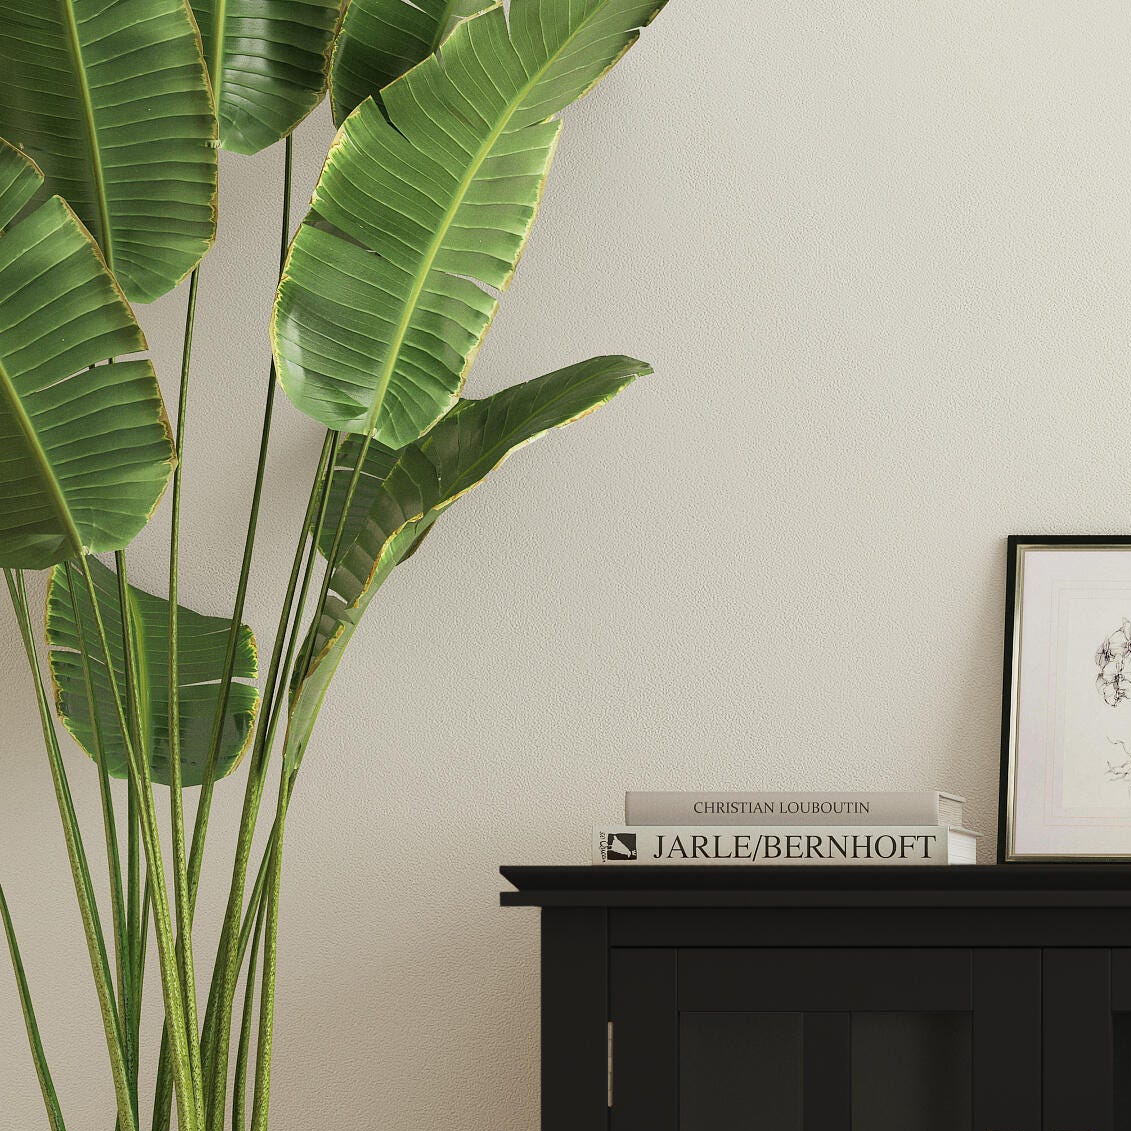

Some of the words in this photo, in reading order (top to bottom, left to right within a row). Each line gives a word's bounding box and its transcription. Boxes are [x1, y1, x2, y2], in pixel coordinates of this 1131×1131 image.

[693, 801, 775, 814] CHRISTIAN
[780, 801, 870, 814] LOUBOUTIN
[653, 834, 937, 862] JARLE/BERNHOFT
